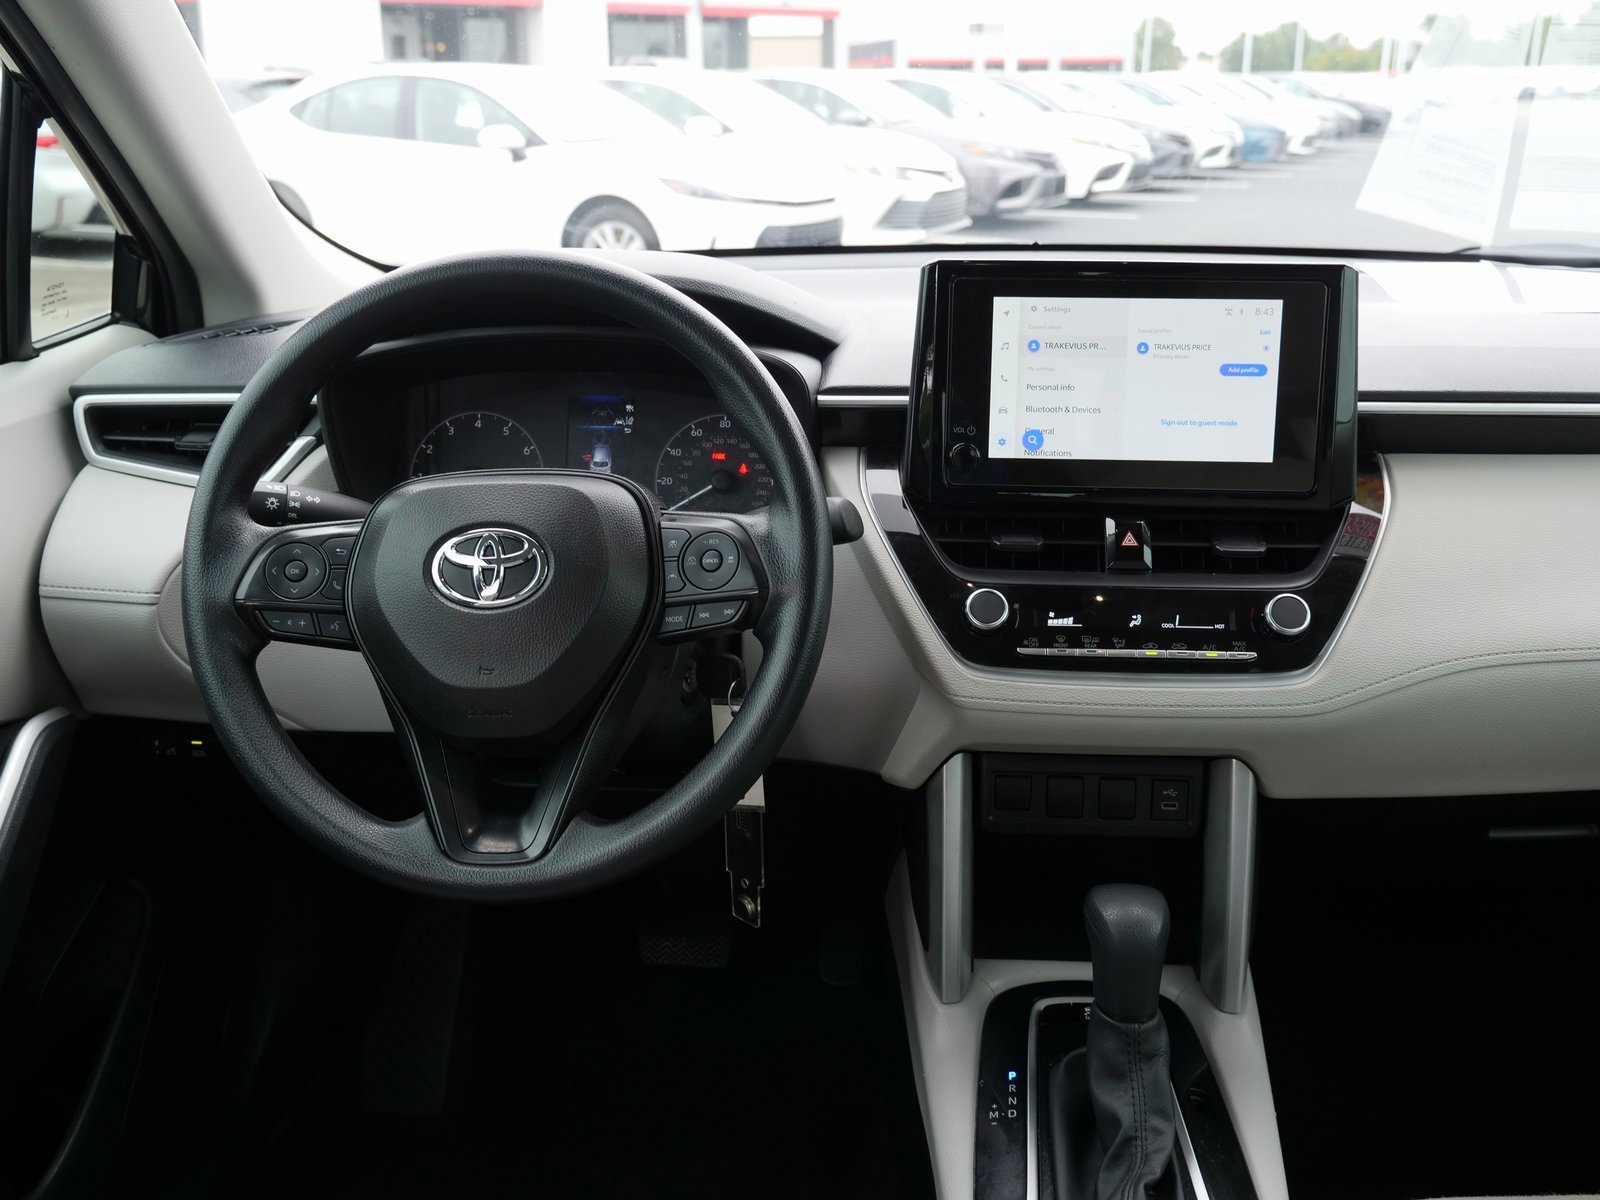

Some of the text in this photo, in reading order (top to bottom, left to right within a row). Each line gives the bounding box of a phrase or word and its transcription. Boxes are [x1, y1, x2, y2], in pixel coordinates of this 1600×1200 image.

[1043, 306, 1071, 314] Settings
[1255, 308, 1274, 316] 8:43
[474, 420, 481, 428] 4
[448, 427, 455, 435] 3
[503, 427, 509, 436] 5
[426, 445, 433, 454] 2
[523, 446, 530, 455] 6
[1008, 1071, 1016, 1080] P
